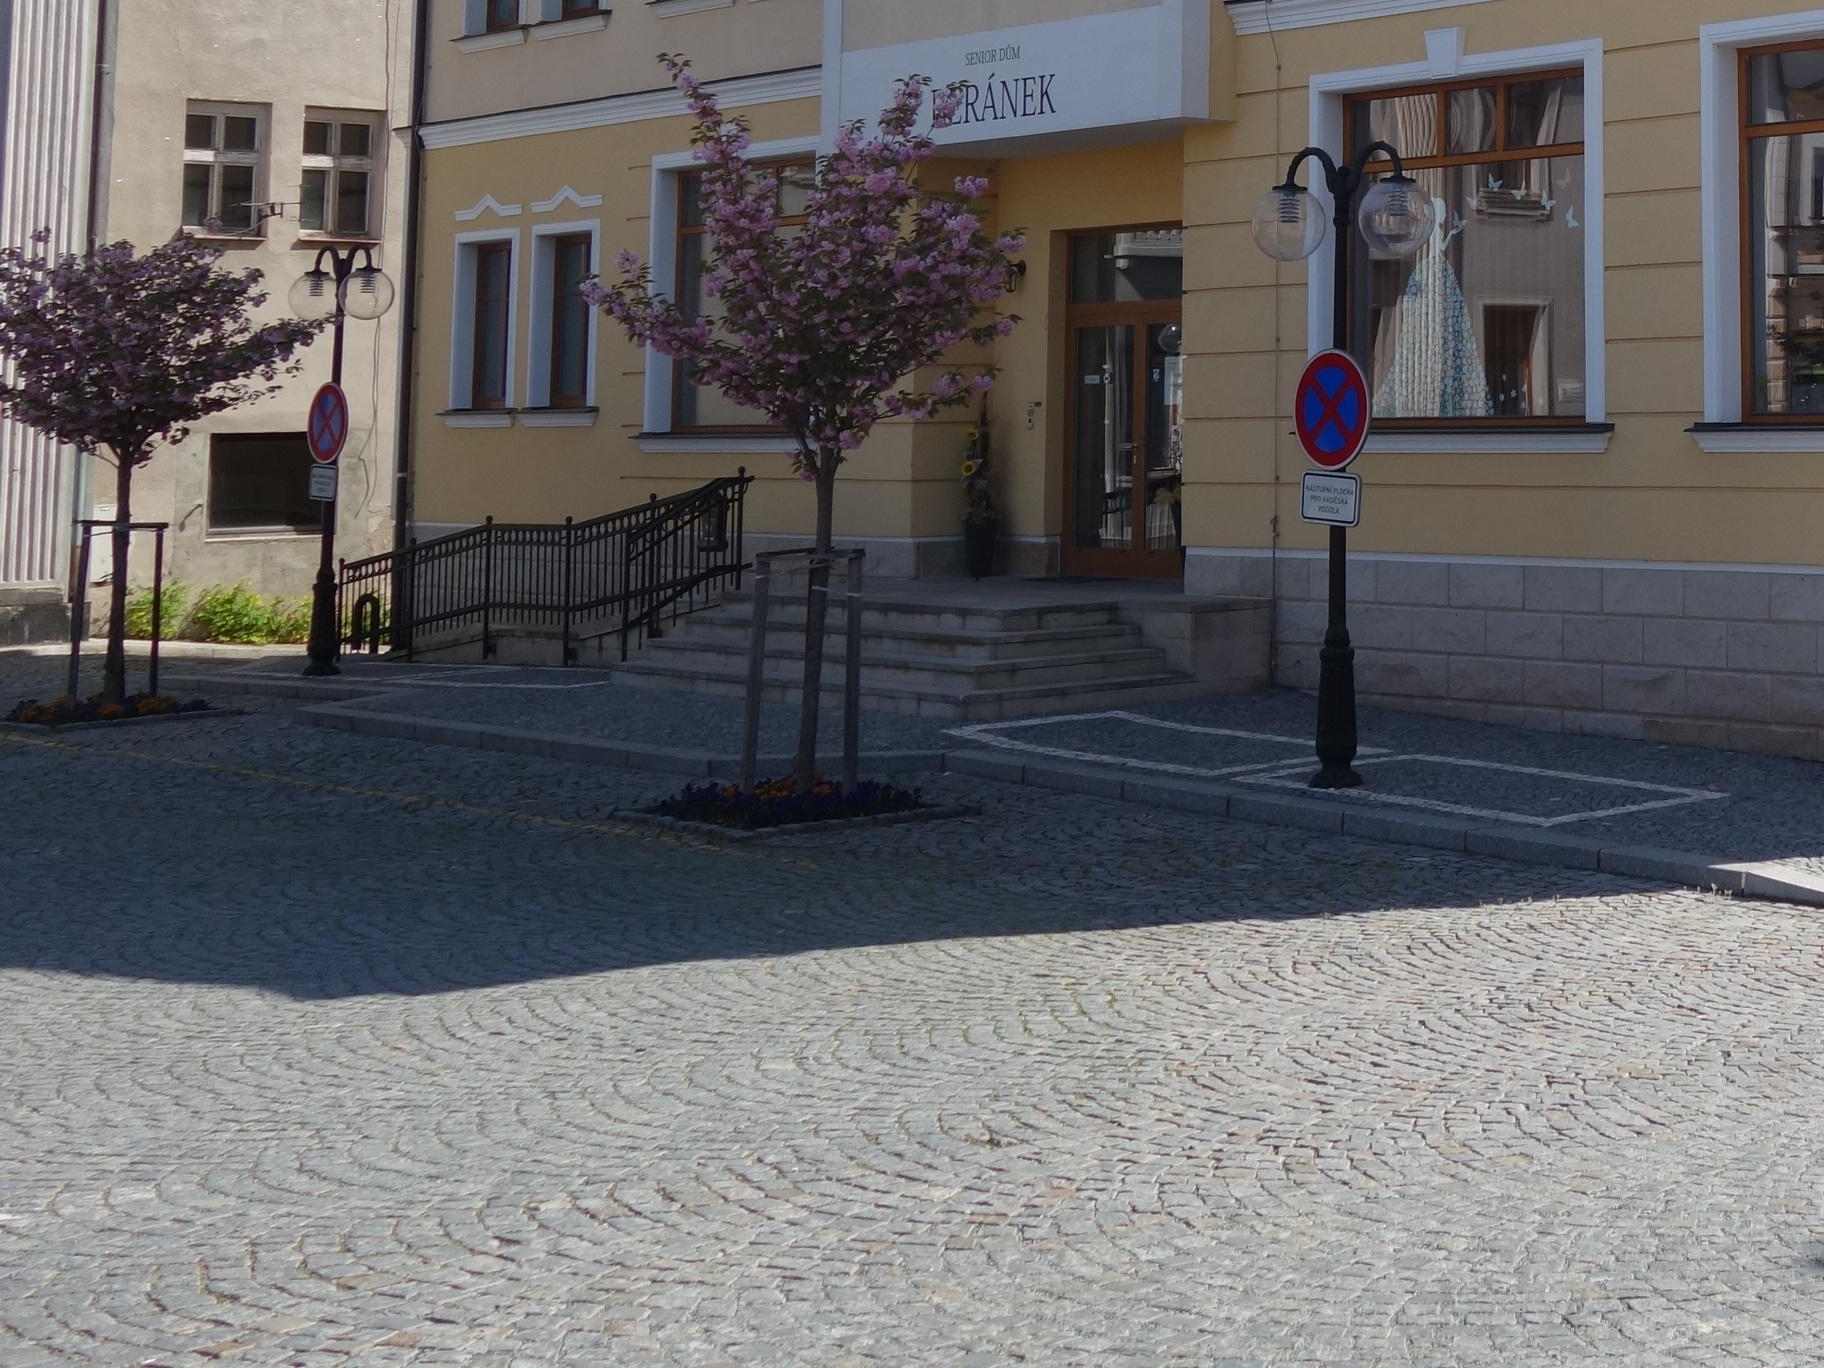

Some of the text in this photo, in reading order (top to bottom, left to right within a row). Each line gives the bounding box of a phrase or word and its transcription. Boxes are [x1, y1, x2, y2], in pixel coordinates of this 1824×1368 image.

[965, 44, 1021, 66] SENIOR DŮM
[931, 72, 1057, 127] RÁNEK
